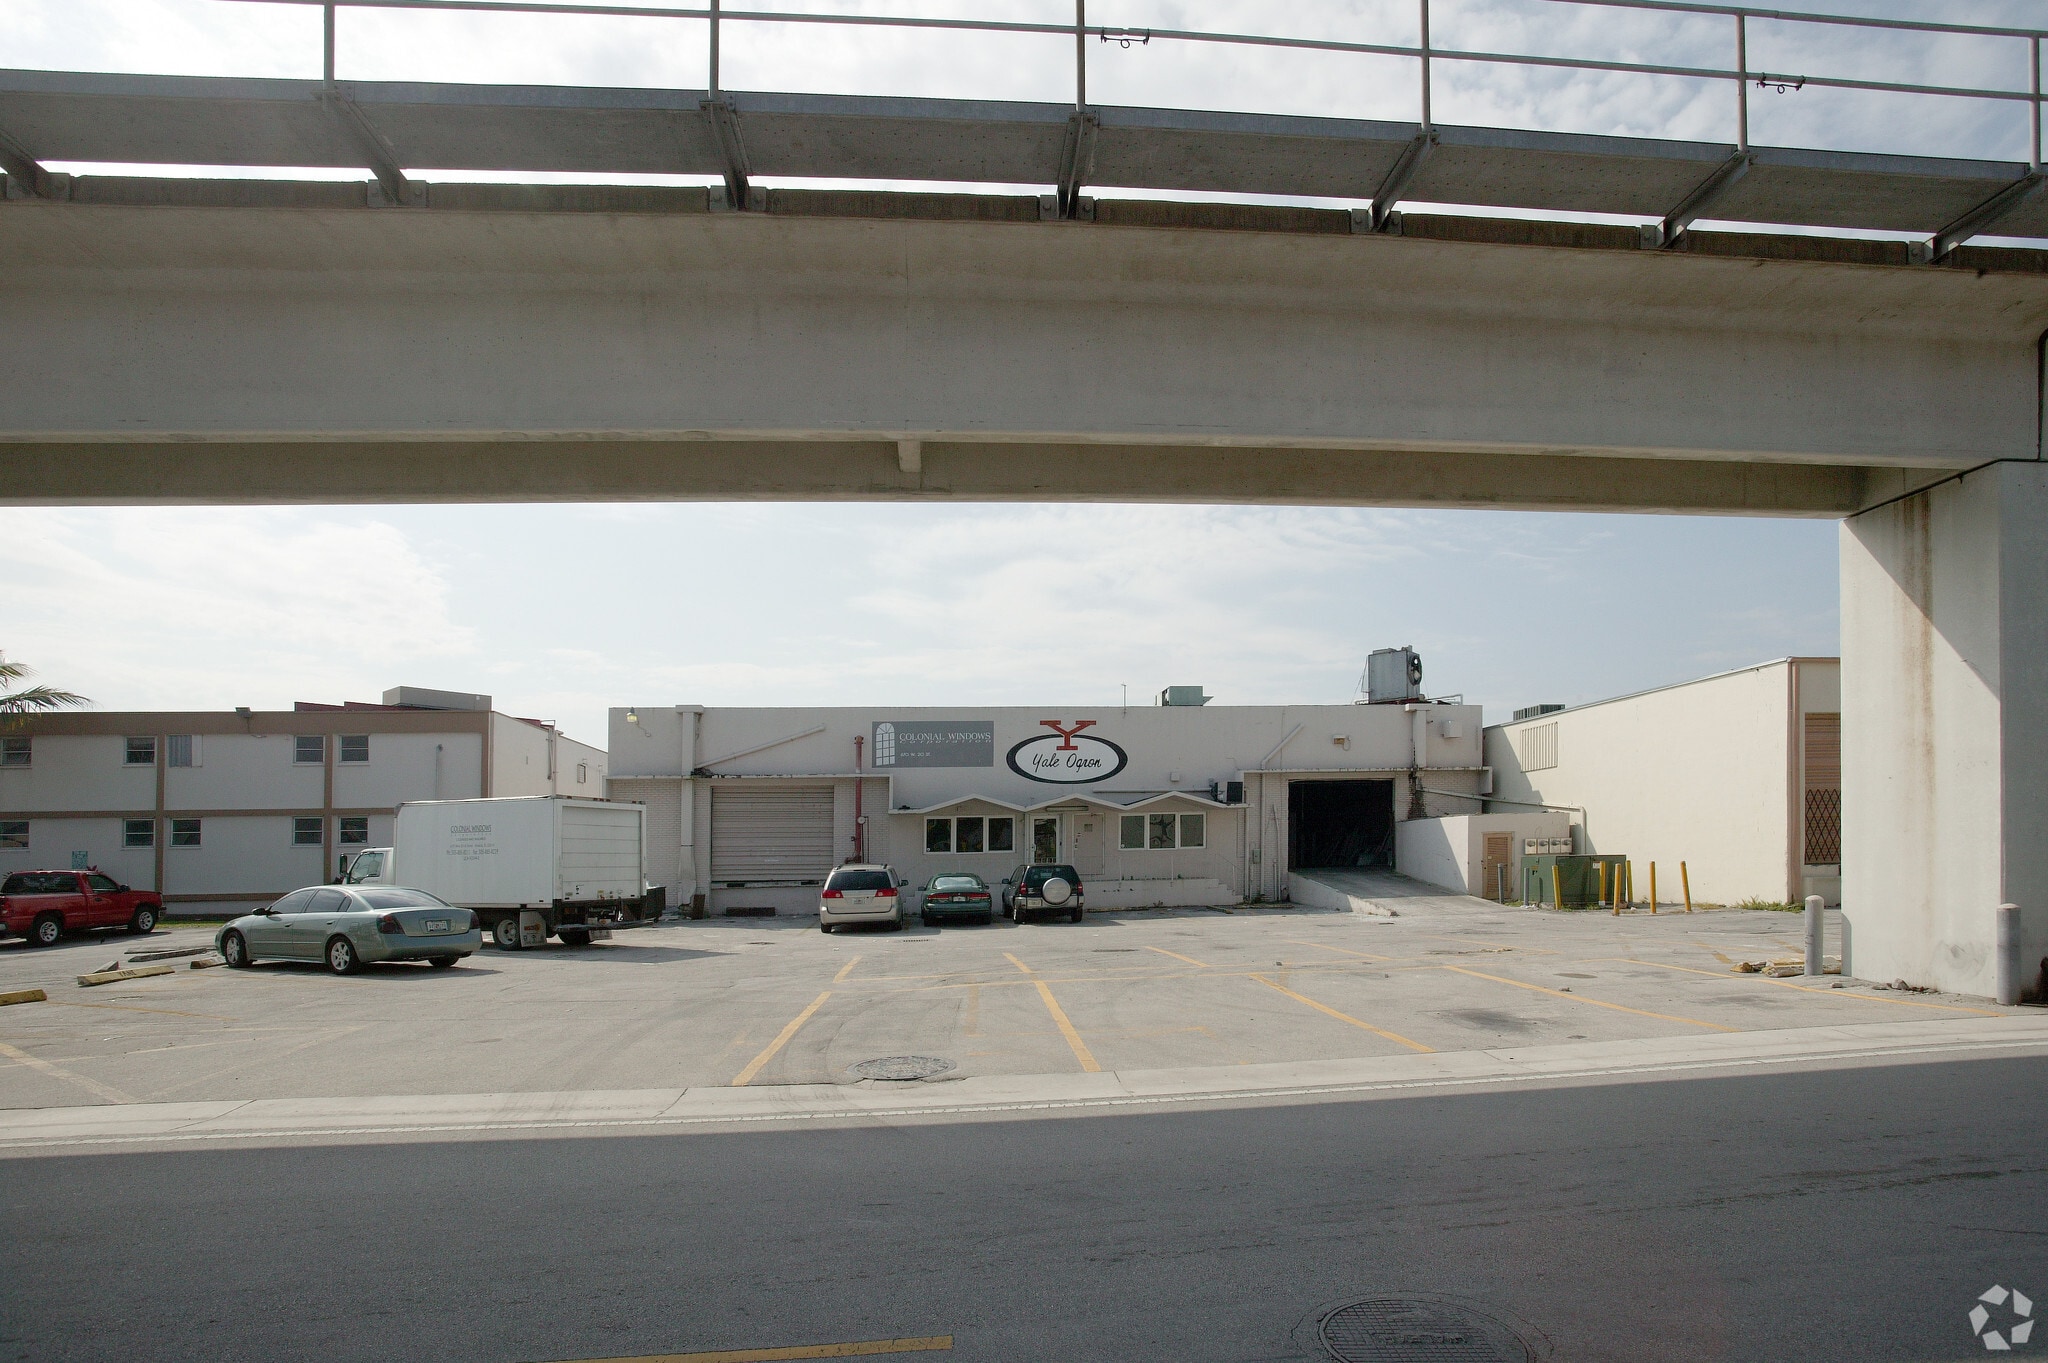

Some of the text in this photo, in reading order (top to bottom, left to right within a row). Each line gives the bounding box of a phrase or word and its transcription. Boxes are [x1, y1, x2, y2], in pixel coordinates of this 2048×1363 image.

[899, 731, 991, 740] COLONIAL WINDOWS
[1040, 720, 1096, 750] Y
[1032, 753, 1102, 773] Yale Ogron
